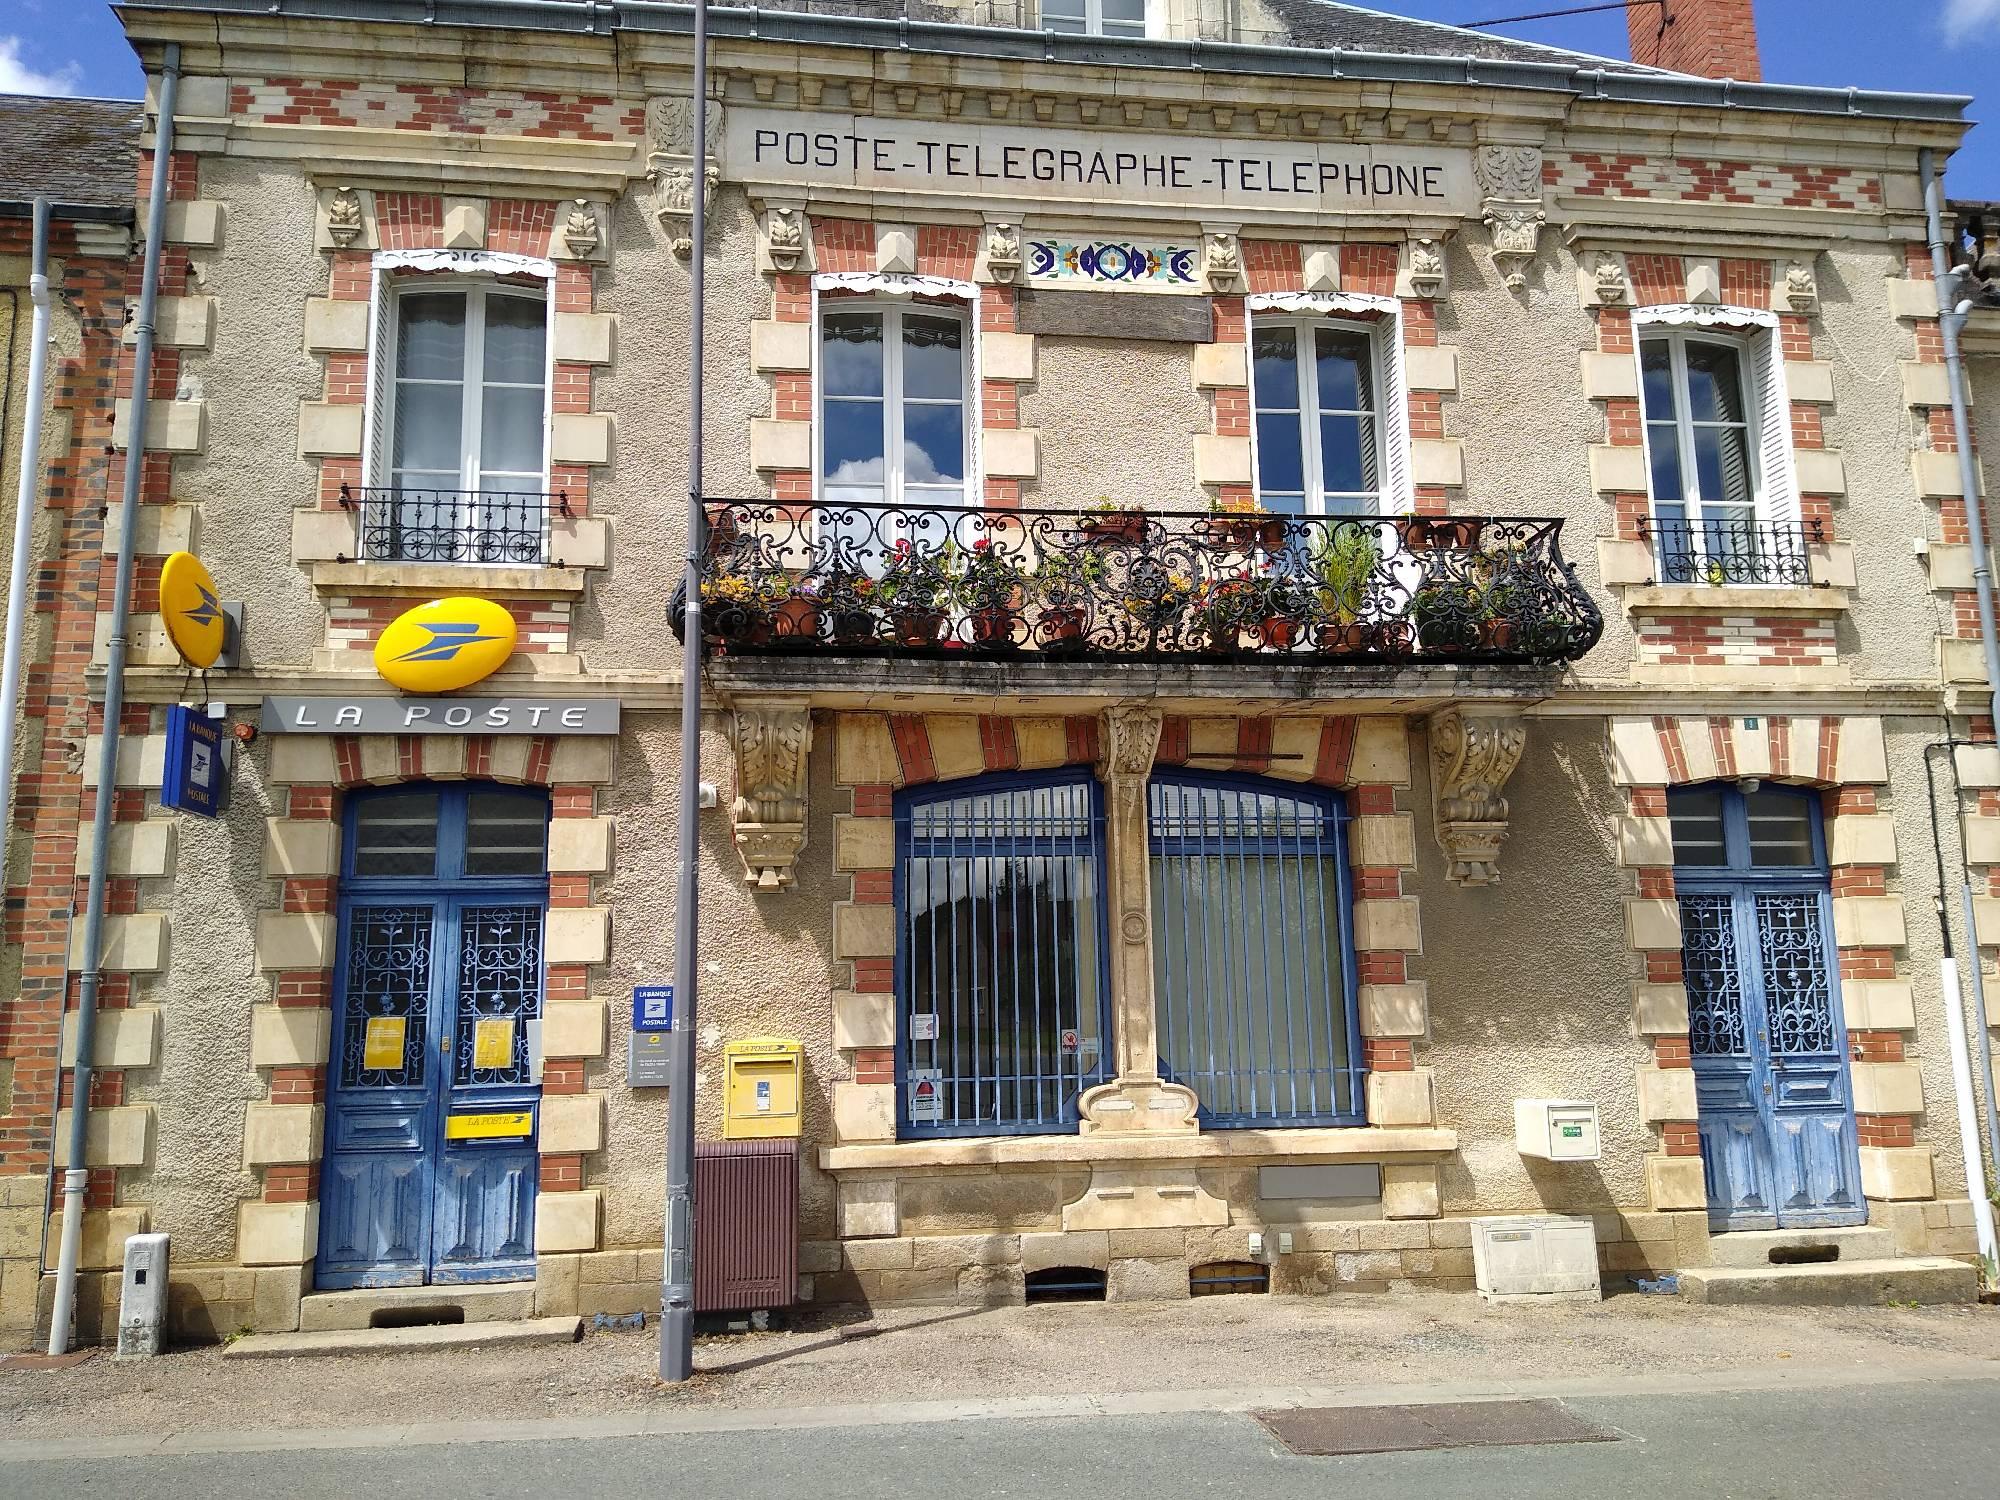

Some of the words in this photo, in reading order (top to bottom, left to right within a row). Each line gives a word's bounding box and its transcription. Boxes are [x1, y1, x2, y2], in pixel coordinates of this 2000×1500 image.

[295, 705, 363, 727] LA
[404, 706, 588, 727] POSTE
[196, 725, 216, 742] BANQUE
[188, 788, 209, 804] POSTALE
[467, 1117, 479, 1126] LA
[481, 1116, 511, 1125] POSTE
